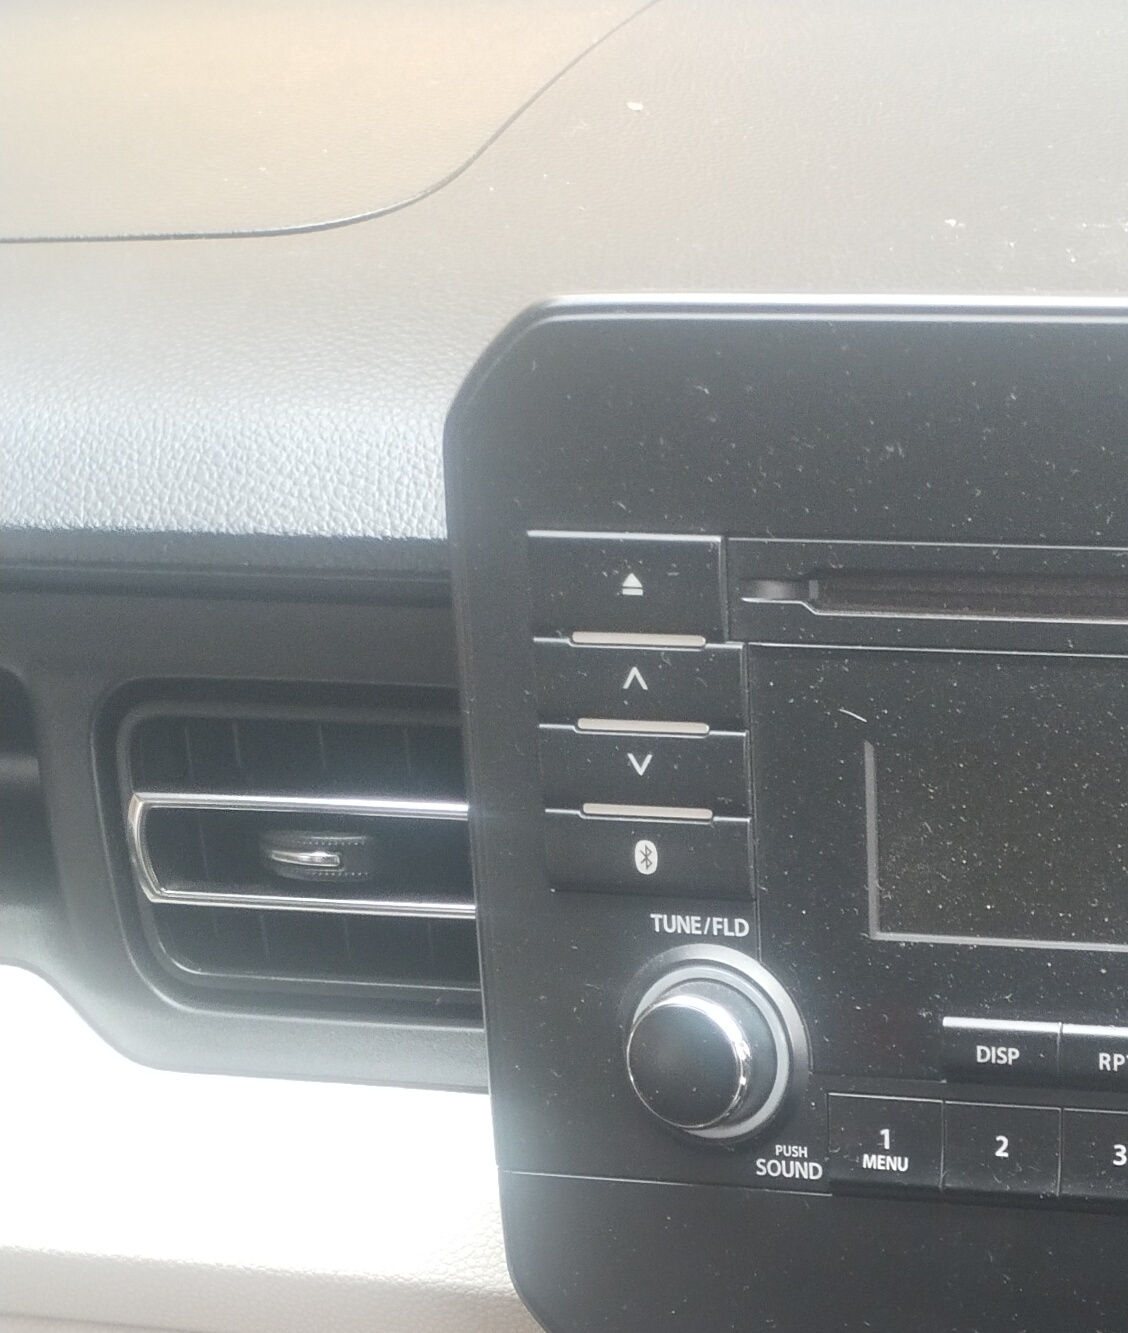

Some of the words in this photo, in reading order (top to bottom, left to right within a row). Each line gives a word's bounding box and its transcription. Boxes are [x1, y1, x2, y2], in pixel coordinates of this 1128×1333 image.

[649, 913, 750, 938] TUNE/FLD
[976, 1045, 1020, 1066] DISP
[880, 1128, 890, 1150] 1
[994, 1135, 1009, 1158] 2
[775, 1144, 808, 1159] PUSH
[862, 1153, 909, 1172] MENU
[1112, 1143, 1128, 1166] 3
[755, 1158, 823, 1181] SOUND
